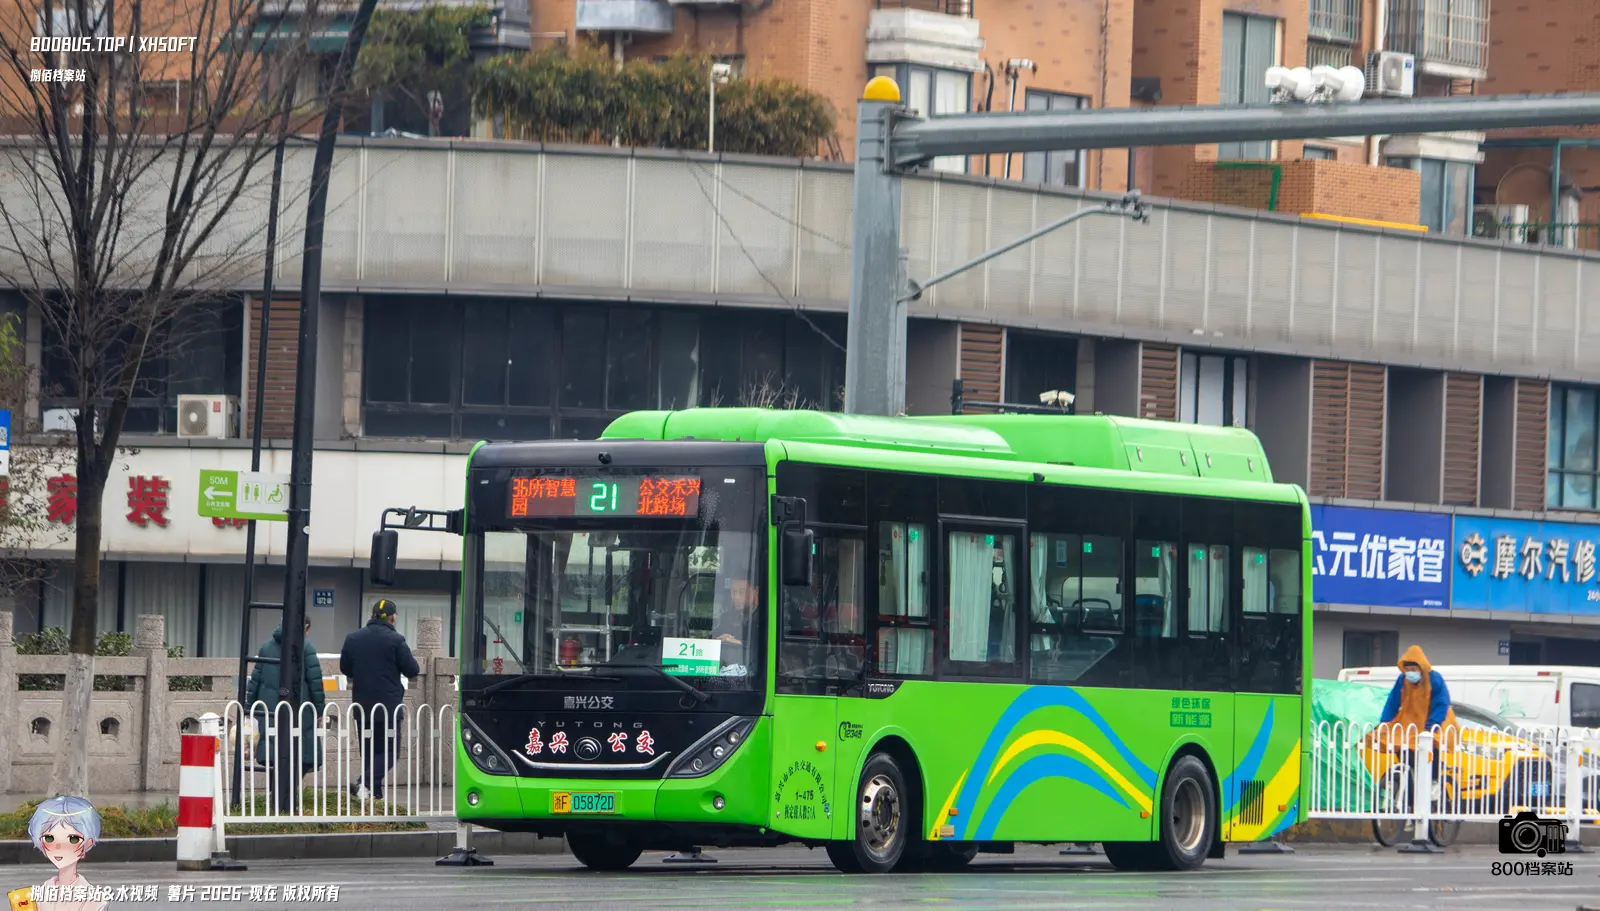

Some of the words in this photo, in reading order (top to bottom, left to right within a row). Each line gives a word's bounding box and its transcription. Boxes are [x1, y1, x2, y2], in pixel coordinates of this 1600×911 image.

[209, 476, 228, 484] 50M
[639, 478, 701, 496] 公交禾兴
[591, 482, 618, 511] 21
[512, 497, 528, 516] 园
[637, 497, 686, 515] 北路场
[1494, 534, 1600, 584] 摩尔汽修
[868, 683, 895, 693] YUTONG
[563, 696, 614, 709] 嘉兴公交
[538, 720, 643, 729] YUTONG
[524, 727, 569, 755] 嘉兴
[607, 730, 655, 755] 公交
